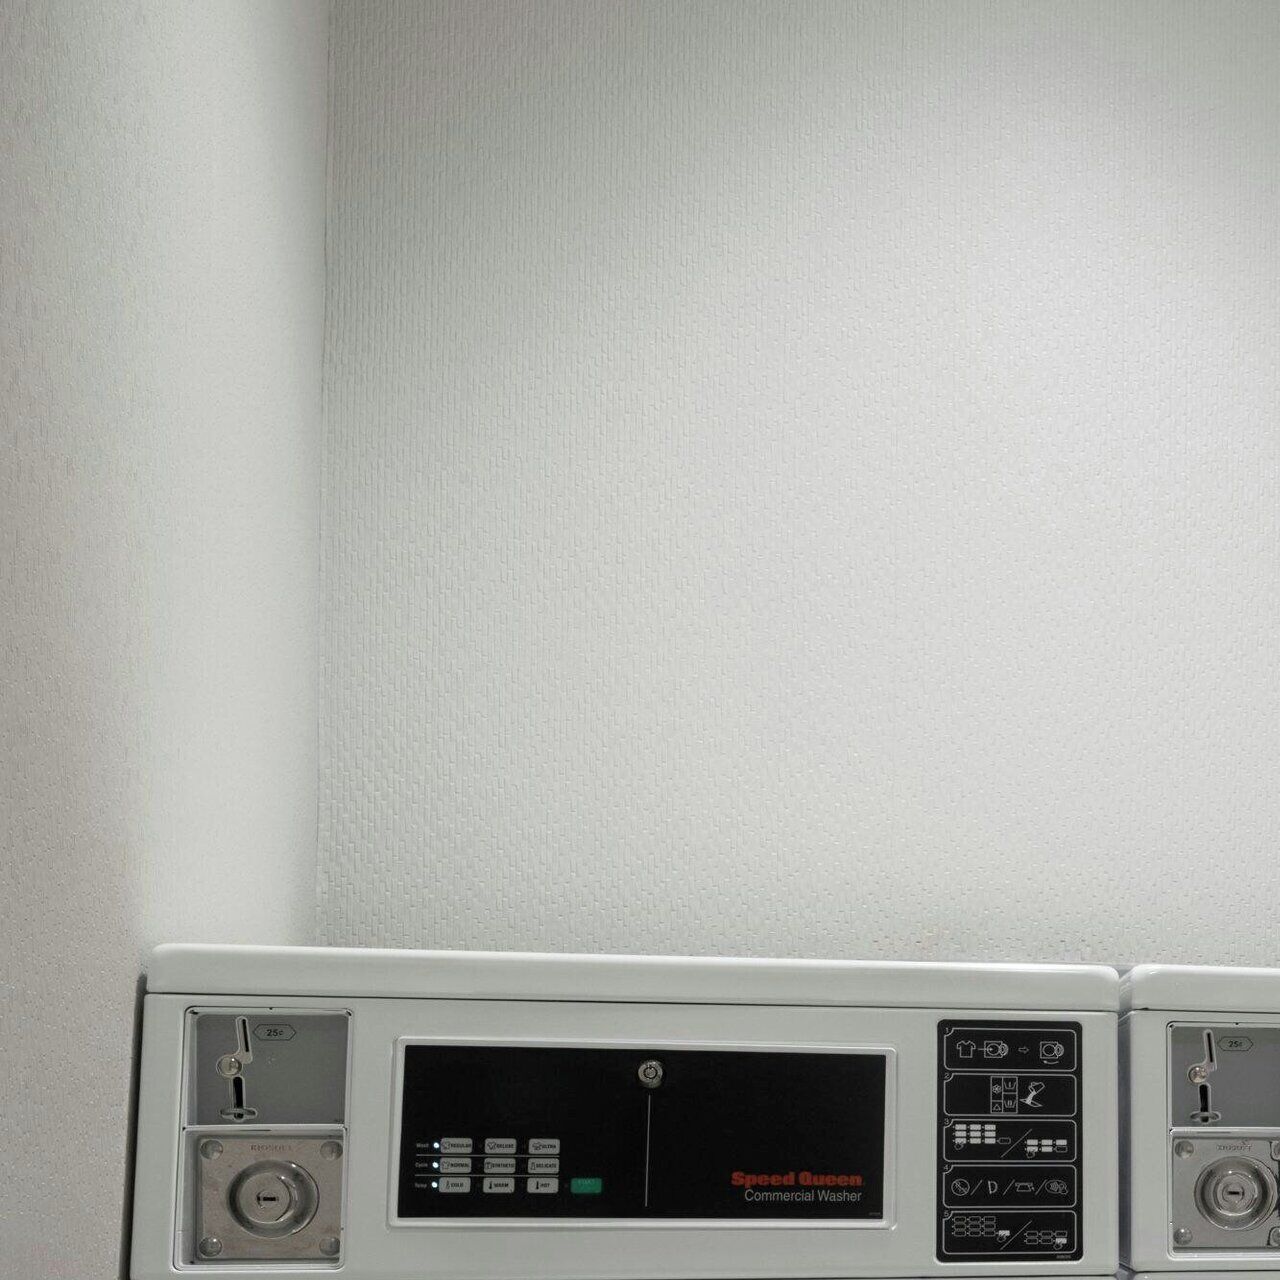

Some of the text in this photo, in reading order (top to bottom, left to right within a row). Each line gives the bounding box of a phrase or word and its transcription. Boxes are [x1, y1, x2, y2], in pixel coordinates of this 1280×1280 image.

[731, 1171, 863, 1188] Speed Queen
[744, 1189, 862, 1202] Commercial Washer
